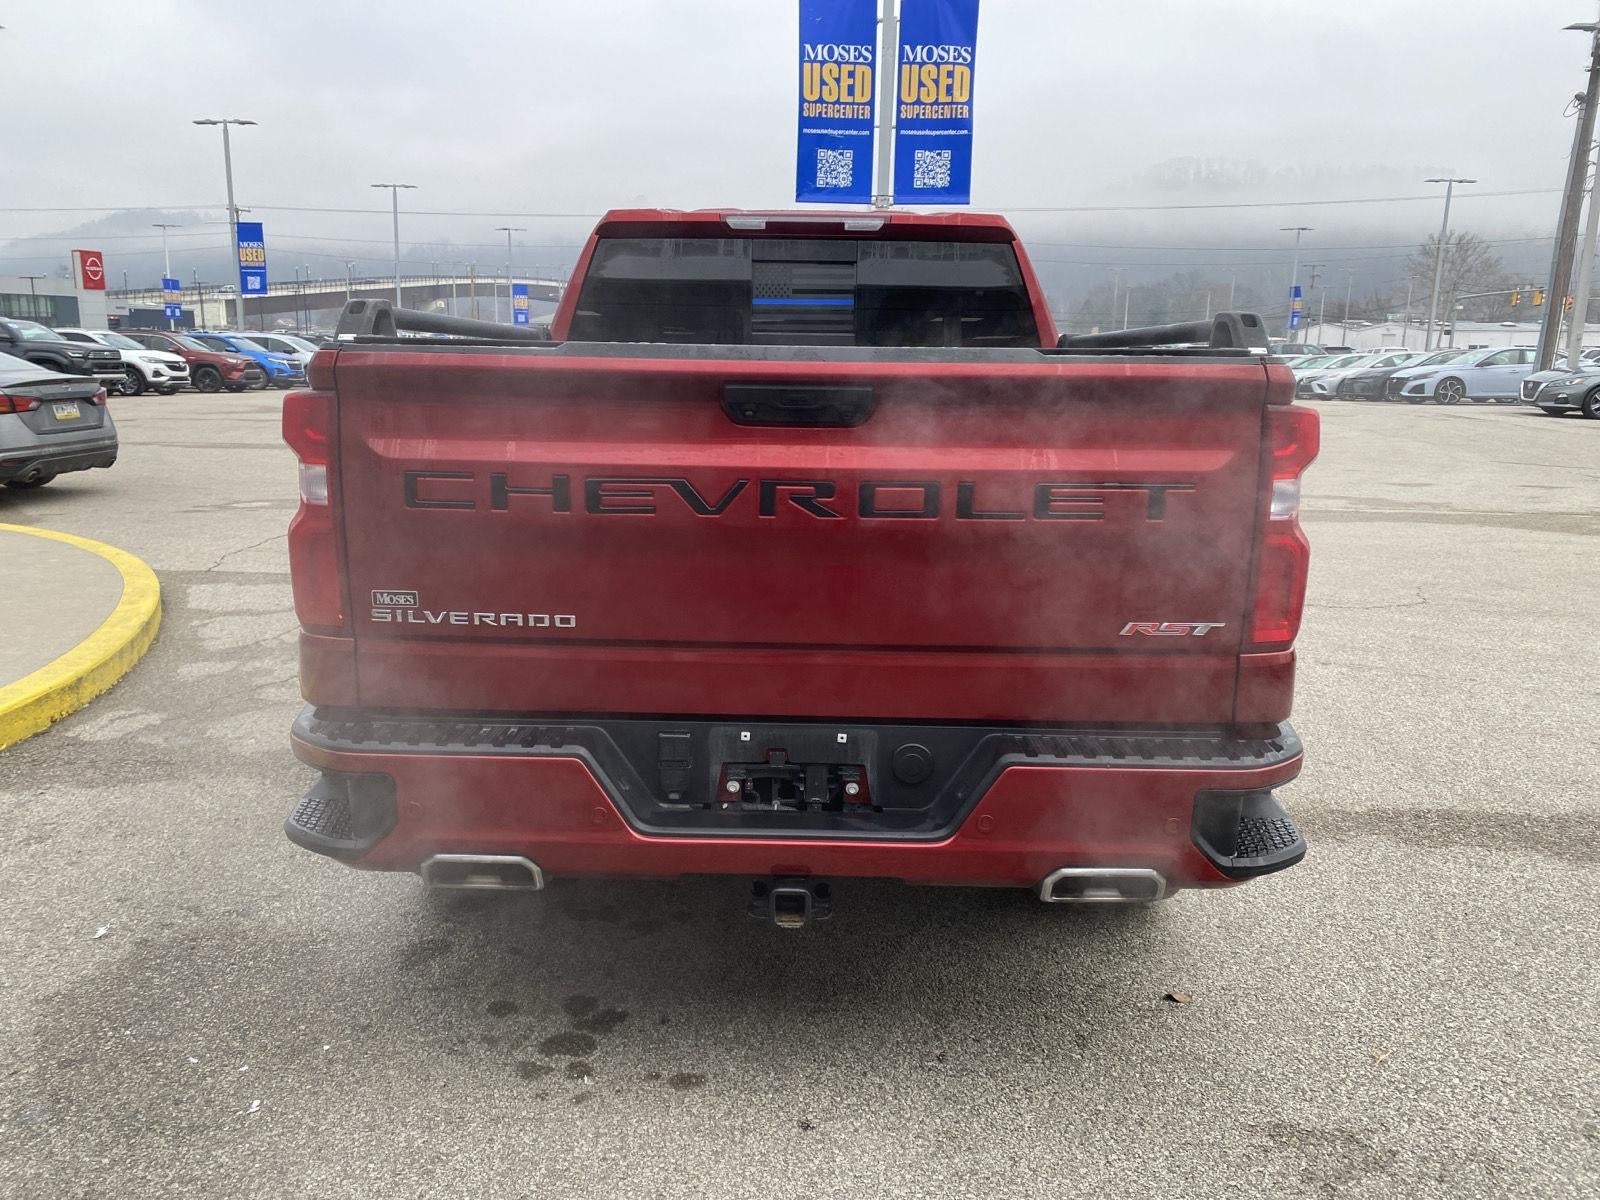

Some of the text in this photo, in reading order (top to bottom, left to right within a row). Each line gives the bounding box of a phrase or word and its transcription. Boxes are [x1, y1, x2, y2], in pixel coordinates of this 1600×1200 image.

[803, 44, 872, 63] MOSES
[902, 45, 971, 64] MOSES
[803, 63, 872, 103] USED
[901, 64, 971, 103] USED
[803, 103, 871, 119] SUPERCENTER
[900, 104, 969, 119] SUPERCENTER
[802, 127, 870, 136] mosesusedsupercenter.com
[900, 128, 969, 136] mosesusedsupercenter.com
[240, 248, 265, 261] USED
[404, 471, 1197, 523] CHEVROLET
[371, 608, 576, 628] SILVERADO
[1119, 621, 1226, 636] RST
